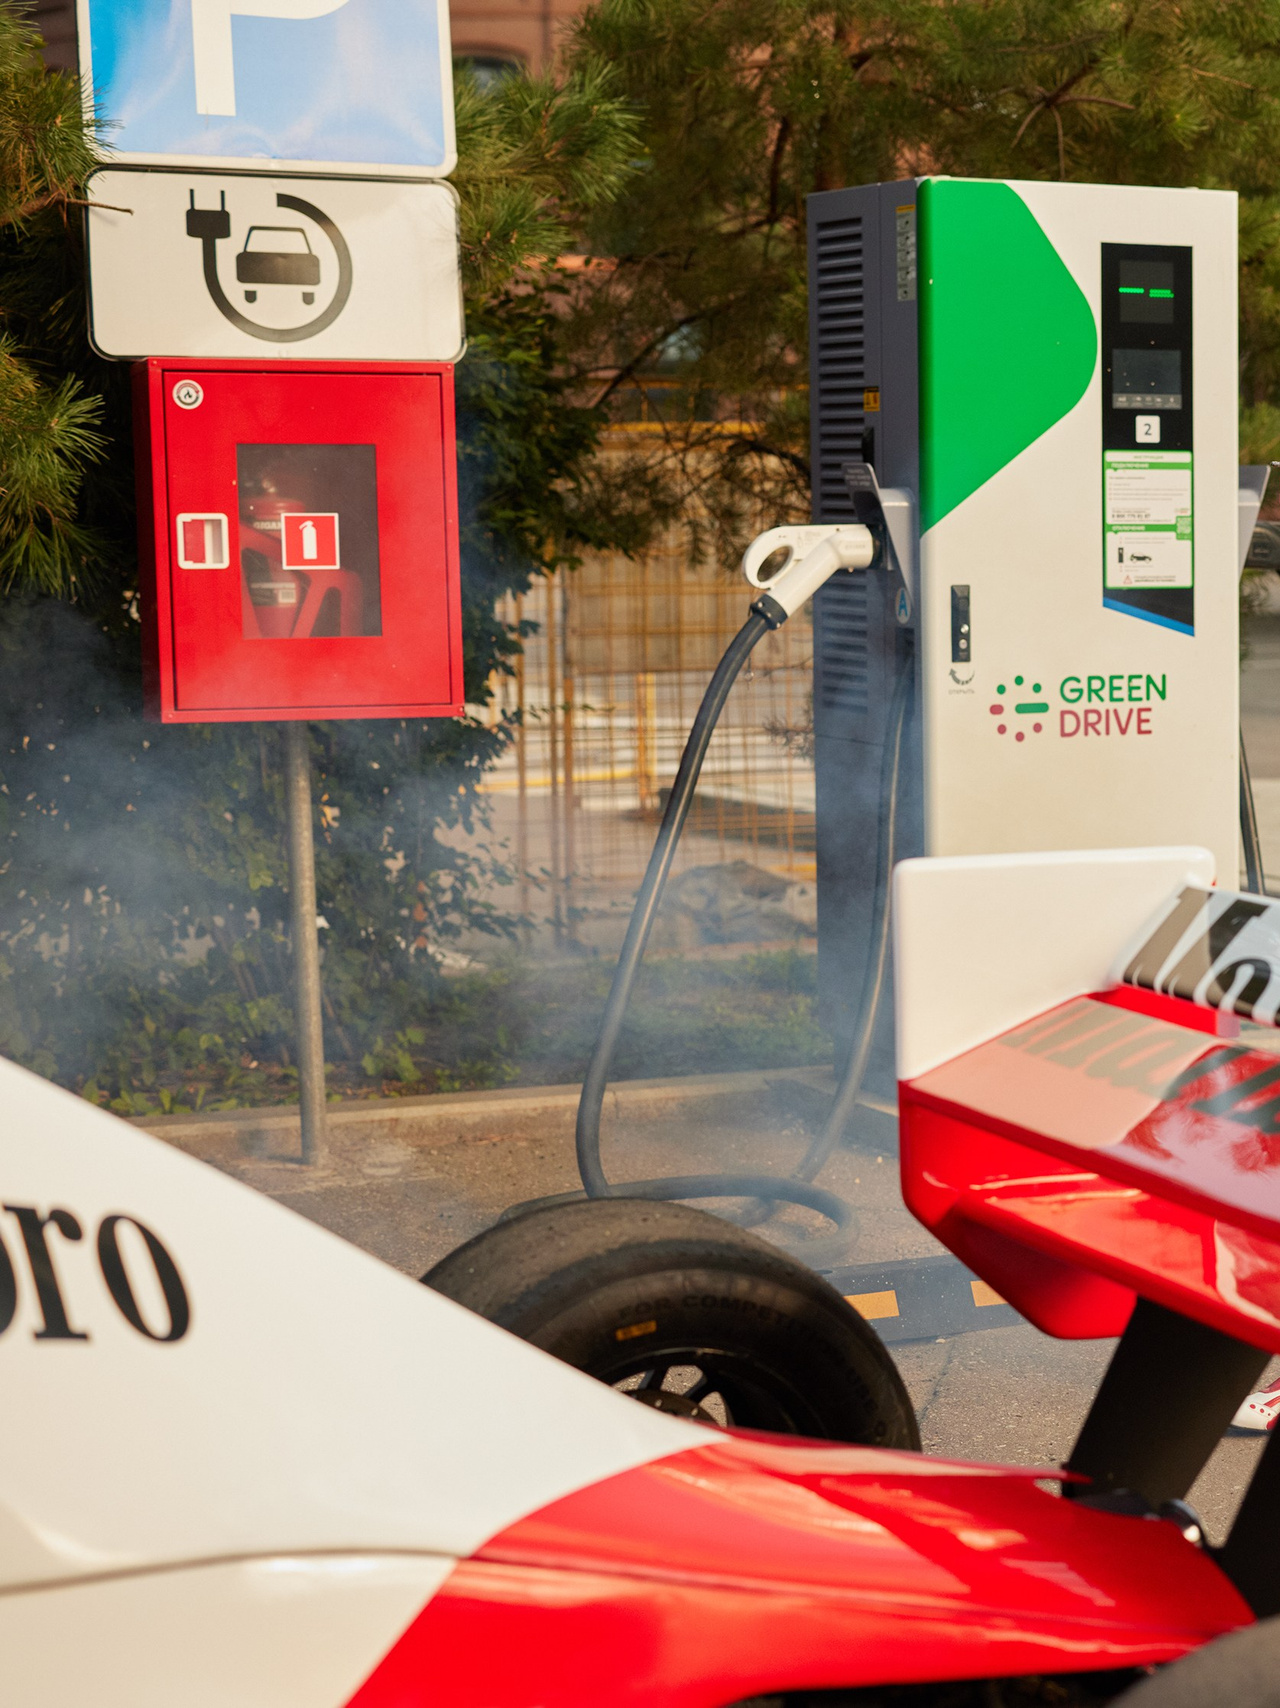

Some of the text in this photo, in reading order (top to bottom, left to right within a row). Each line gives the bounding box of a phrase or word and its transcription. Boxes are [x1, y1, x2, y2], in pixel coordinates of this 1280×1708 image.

[1143, 423, 1153, 436] 2
[1059, 673, 1167, 704] GREEN
[1059, 707, 1153, 738] DRIVE
[0, 1204, 191, 1342] ro
